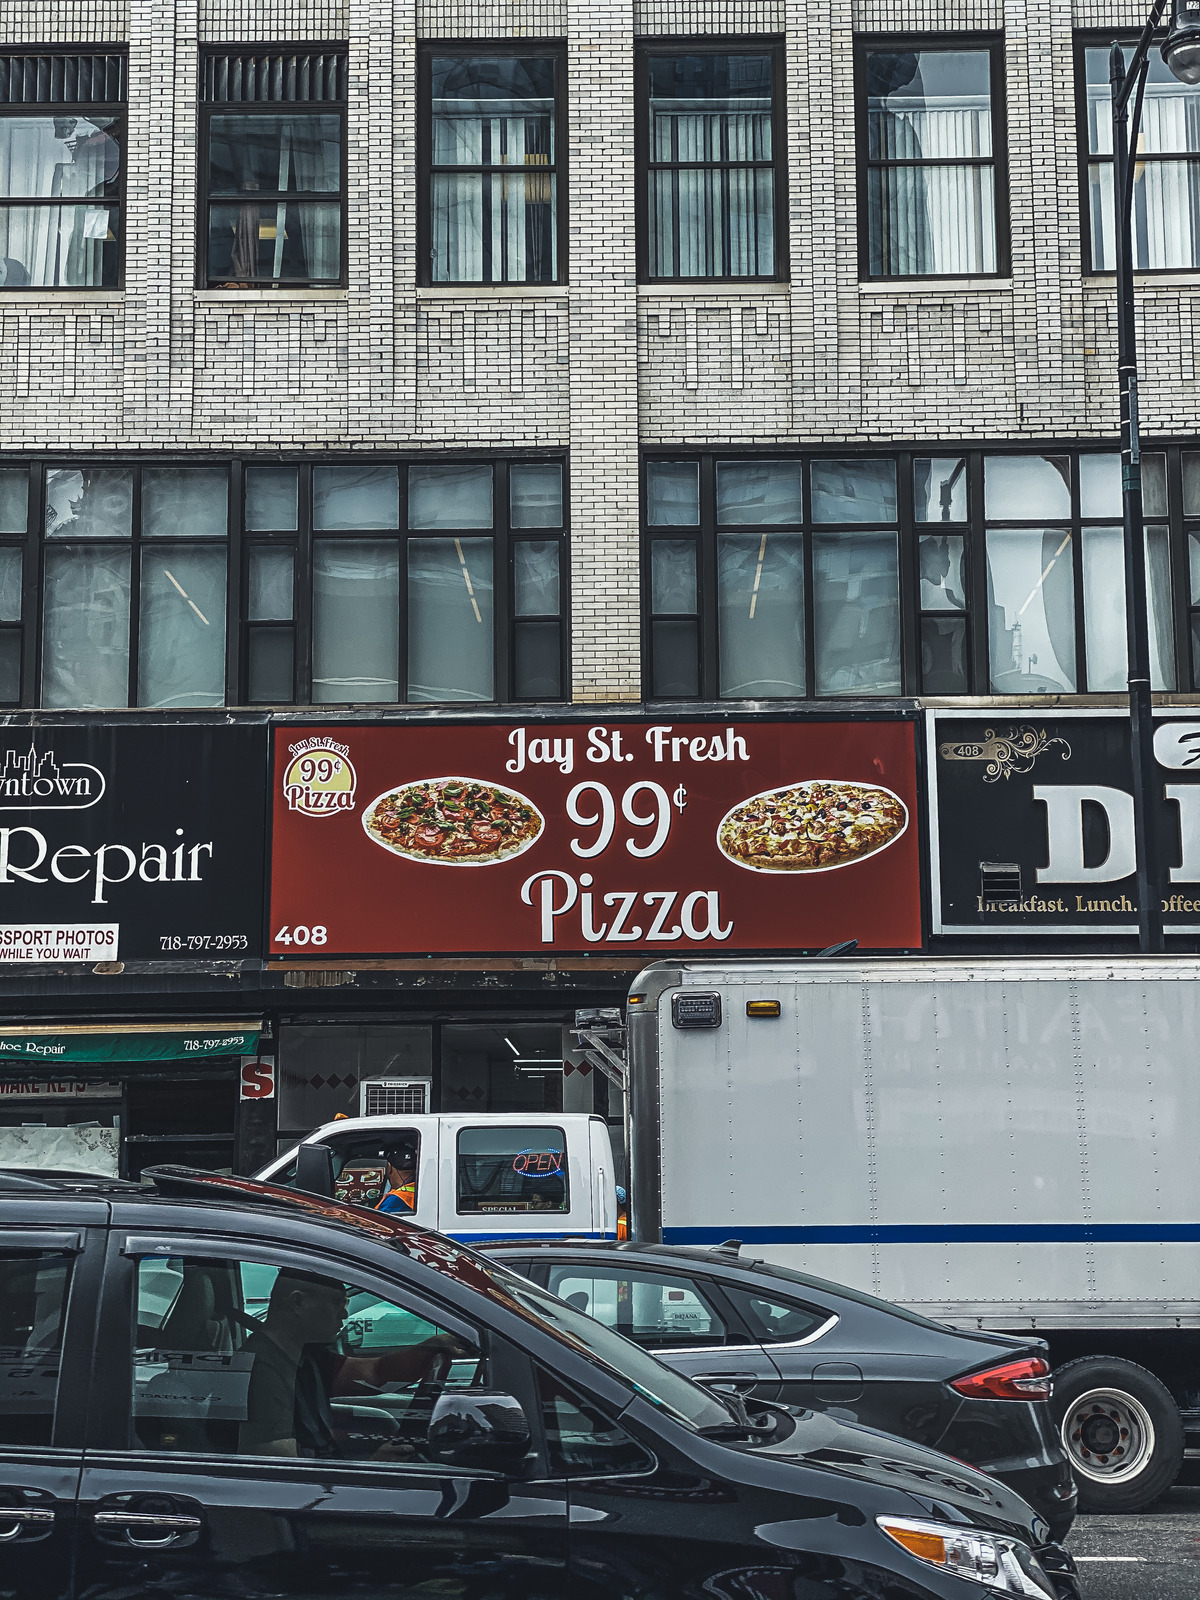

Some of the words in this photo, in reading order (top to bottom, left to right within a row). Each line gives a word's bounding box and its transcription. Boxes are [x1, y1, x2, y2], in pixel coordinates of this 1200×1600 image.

[289, 739, 308, 756] Jay
[323, 737, 350, 757] Fresh
[505, 727, 574, 774] Jay
[586, 726, 634, 763] St.
[645, 726, 750, 762] Fresh
[957, 746, 979, 756] 408
[0, 772, 91, 796] ntown
[285, 785, 353, 809] Pizza
[0, 827, 213, 903] Repair
[520, 870, 734, 943] Pizza
[1075, 895, 1138, 912] Lunch.
[0, 930, 52, 945] SPORT
[56, 930, 114, 945] PHOTOS
[160, 935, 248, 950] 718-797-2953
[274, 925, 328, 946] 408
[36, 948, 59, 959] YOU
[63, 948, 91, 959] WAIT
[25, 1042, 66, 1056] Repair
[183, 1036, 244, 1051] 718-797-2953
[512, 1152, 563, 1173] OPEN
